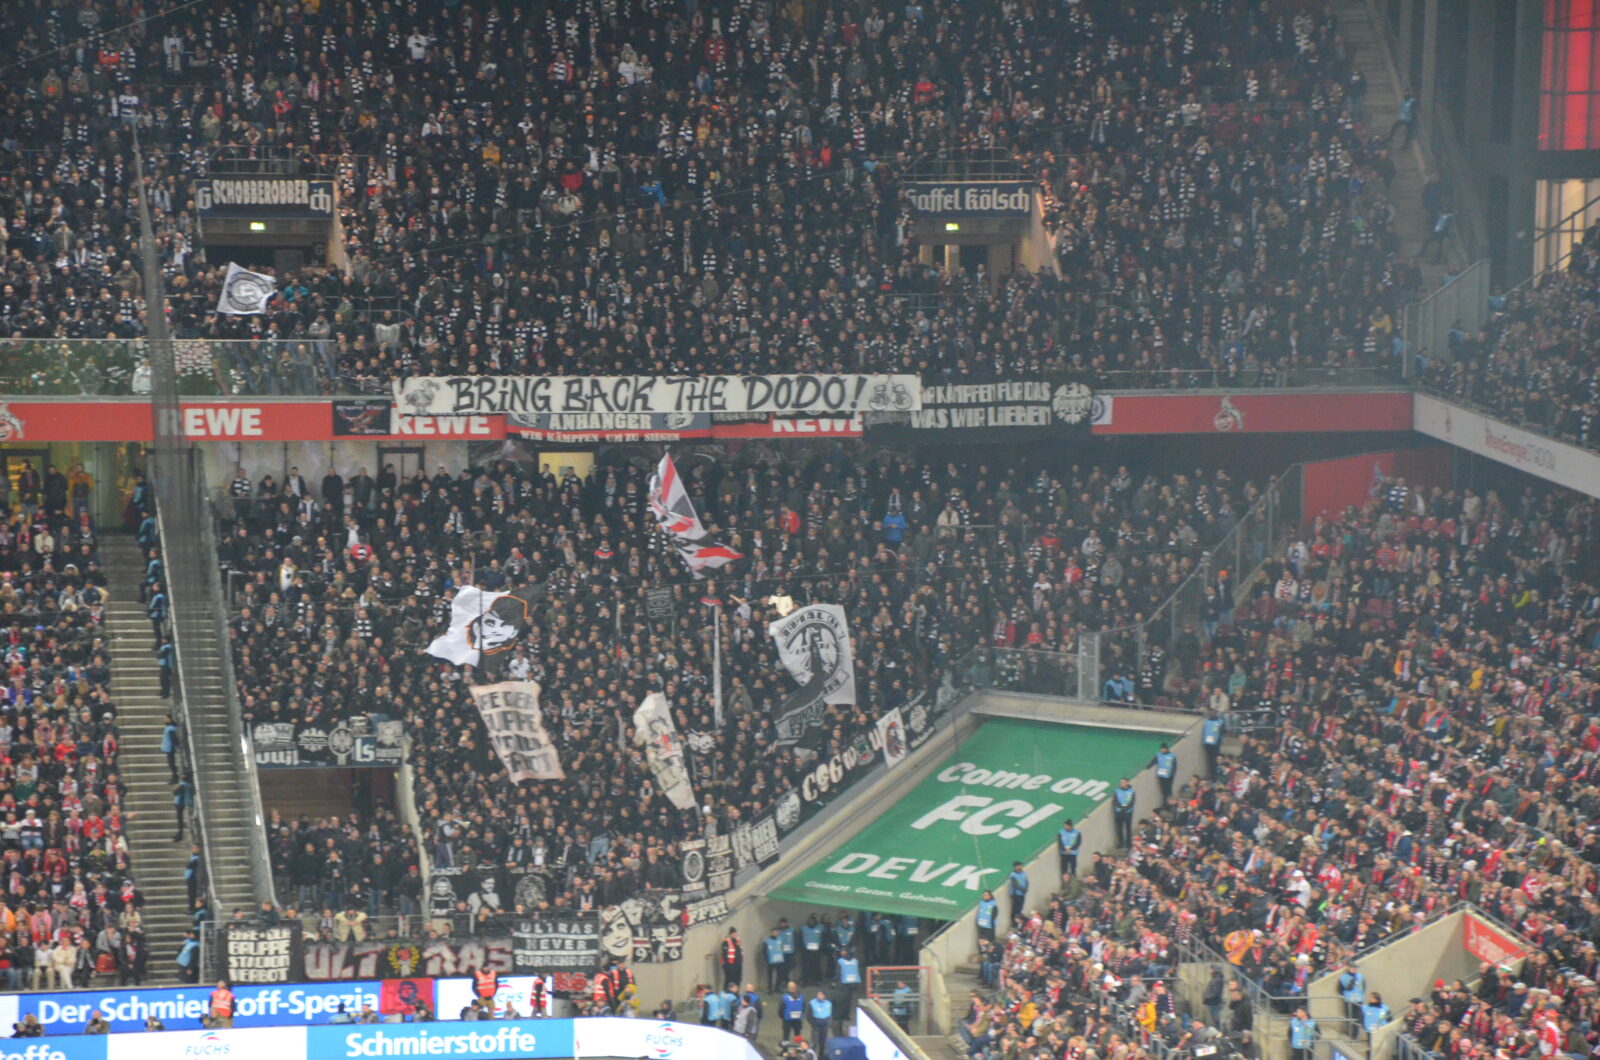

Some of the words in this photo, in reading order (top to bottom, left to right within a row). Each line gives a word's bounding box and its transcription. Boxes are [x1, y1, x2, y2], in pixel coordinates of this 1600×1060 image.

[965, 187, 1030, 212] Kölsch
[562, 376, 656, 412] BACK
[666, 377, 728, 411] THE
[743, 375, 867, 410] DODO!
[1023, 381, 1051, 402] DAS
[159, 408, 263, 436] REWE
[910, 408, 949, 428] WAS
[951, 407, 985, 427] WIR
[987, 405, 1051, 426] LIEBEN
[520, 430, 543, 440] WIR
[546, 430, 599, 442] KÄMPFEN
[605, 432, 623, 442] UM
[625, 432, 640, 442] ZU
[644, 432, 680, 442] SIEGEN
[936, 762, 1052, 791] Come
[1050, 776, 1110, 801] on,
[910, 795, 1064, 839] FC!
[826, 852, 1000, 891] DEVK
[521, 922, 594, 934] ULTRAS
[526, 939, 587, 950] NEVER
[228, 955, 290, 968] STADION
[515, 954, 596, 967] SURRENDER
[228, 968, 289, 982] VERBOT
[38, 1000, 91, 1024] Der
[345, 1027, 536, 1057] Schmierstoffe
